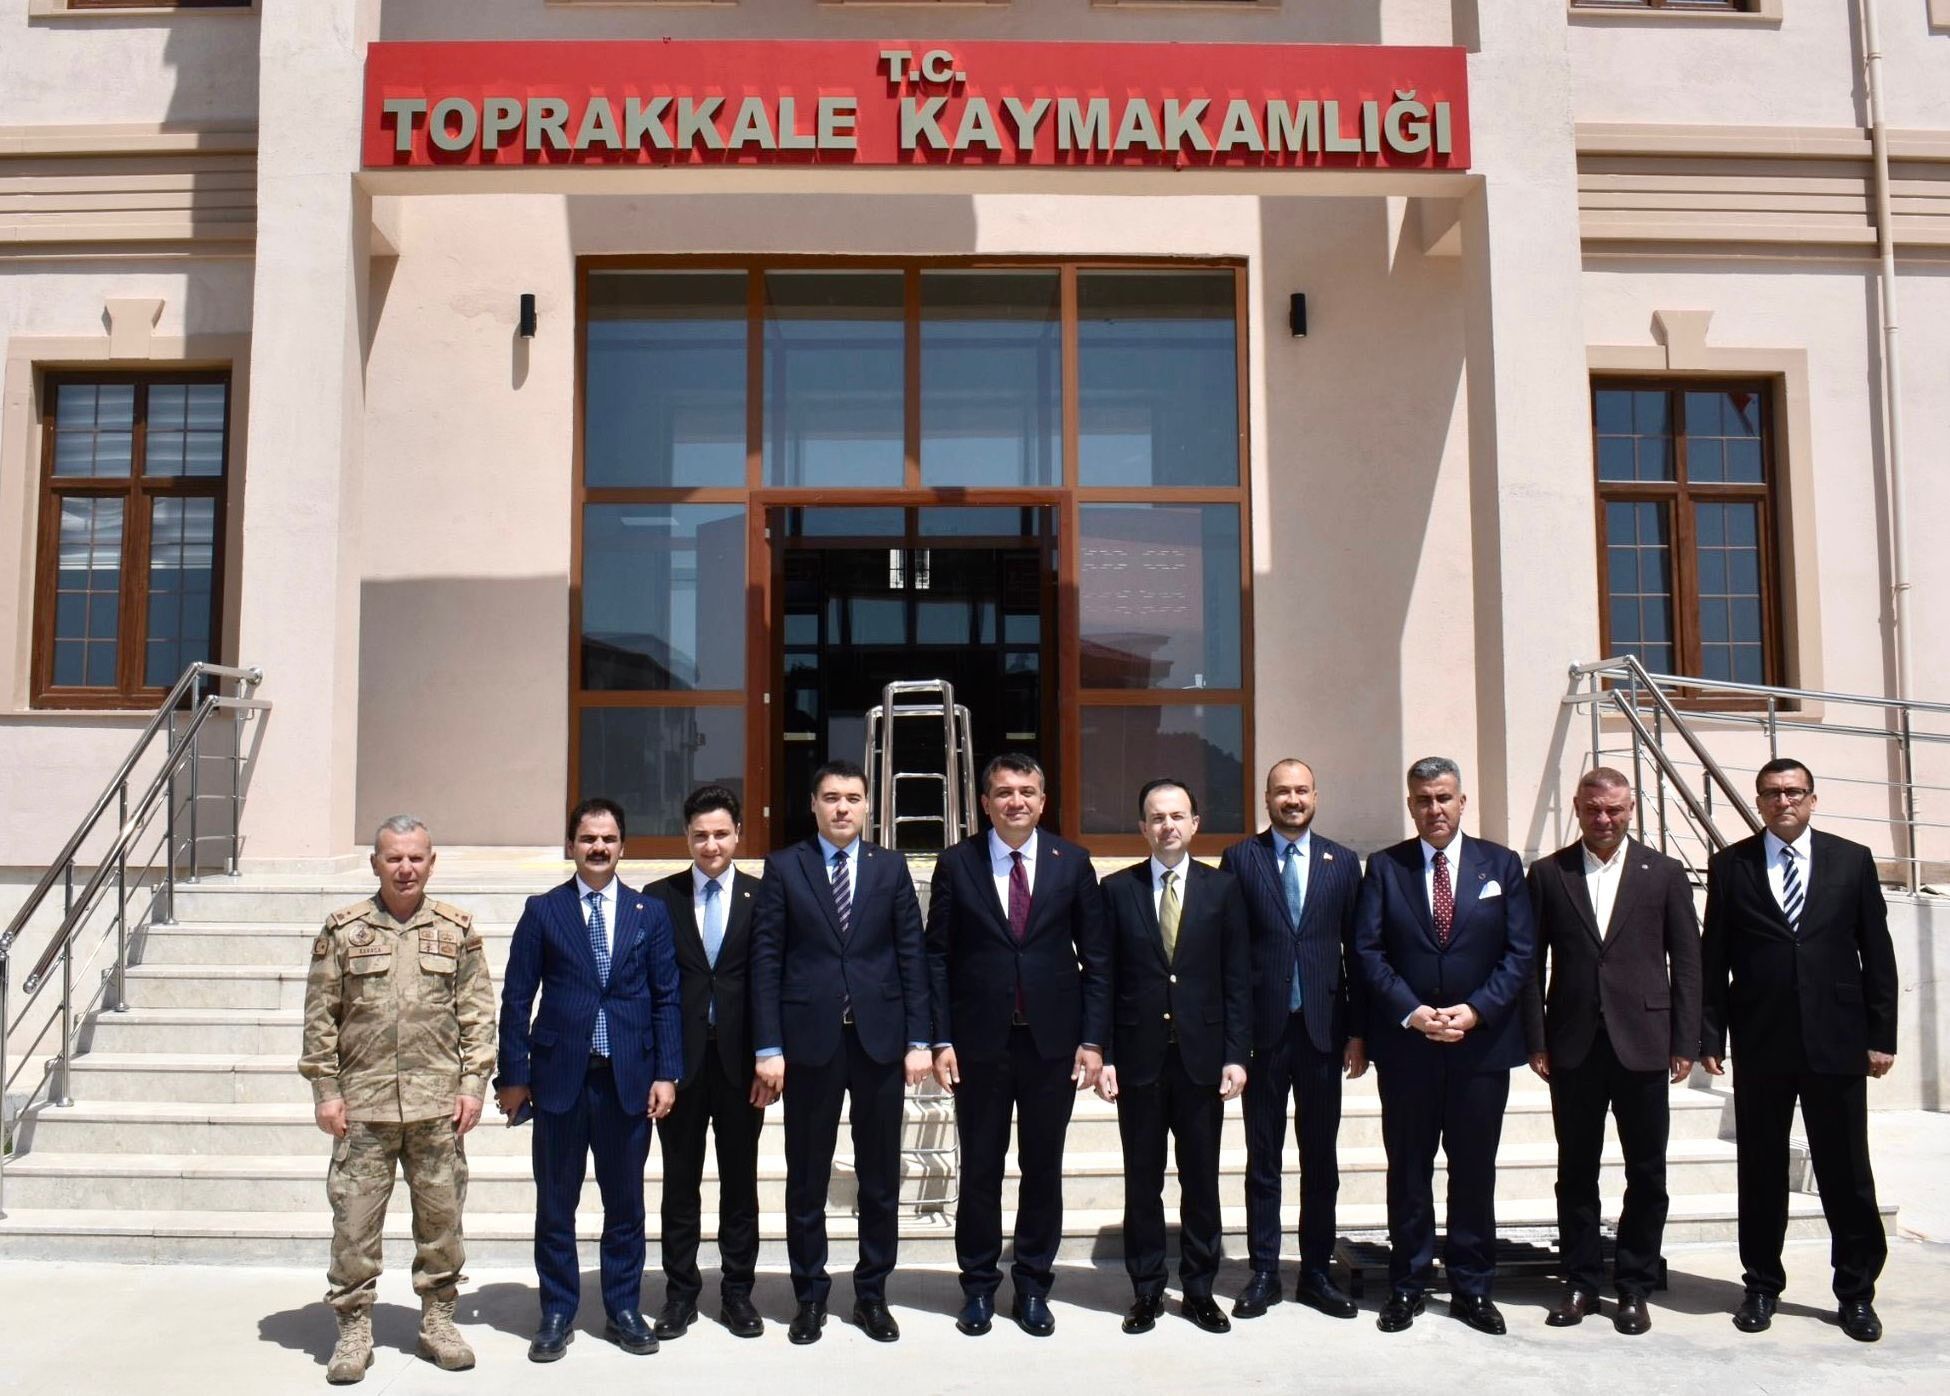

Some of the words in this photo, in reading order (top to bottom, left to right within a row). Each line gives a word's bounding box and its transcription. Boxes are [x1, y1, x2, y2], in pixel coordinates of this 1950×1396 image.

[880, 50, 967, 83] T.C.
[383, 97, 857, 151] TOPRAKKALE
[900, 90, 1452, 154] KAYMAKAMLIĞI
